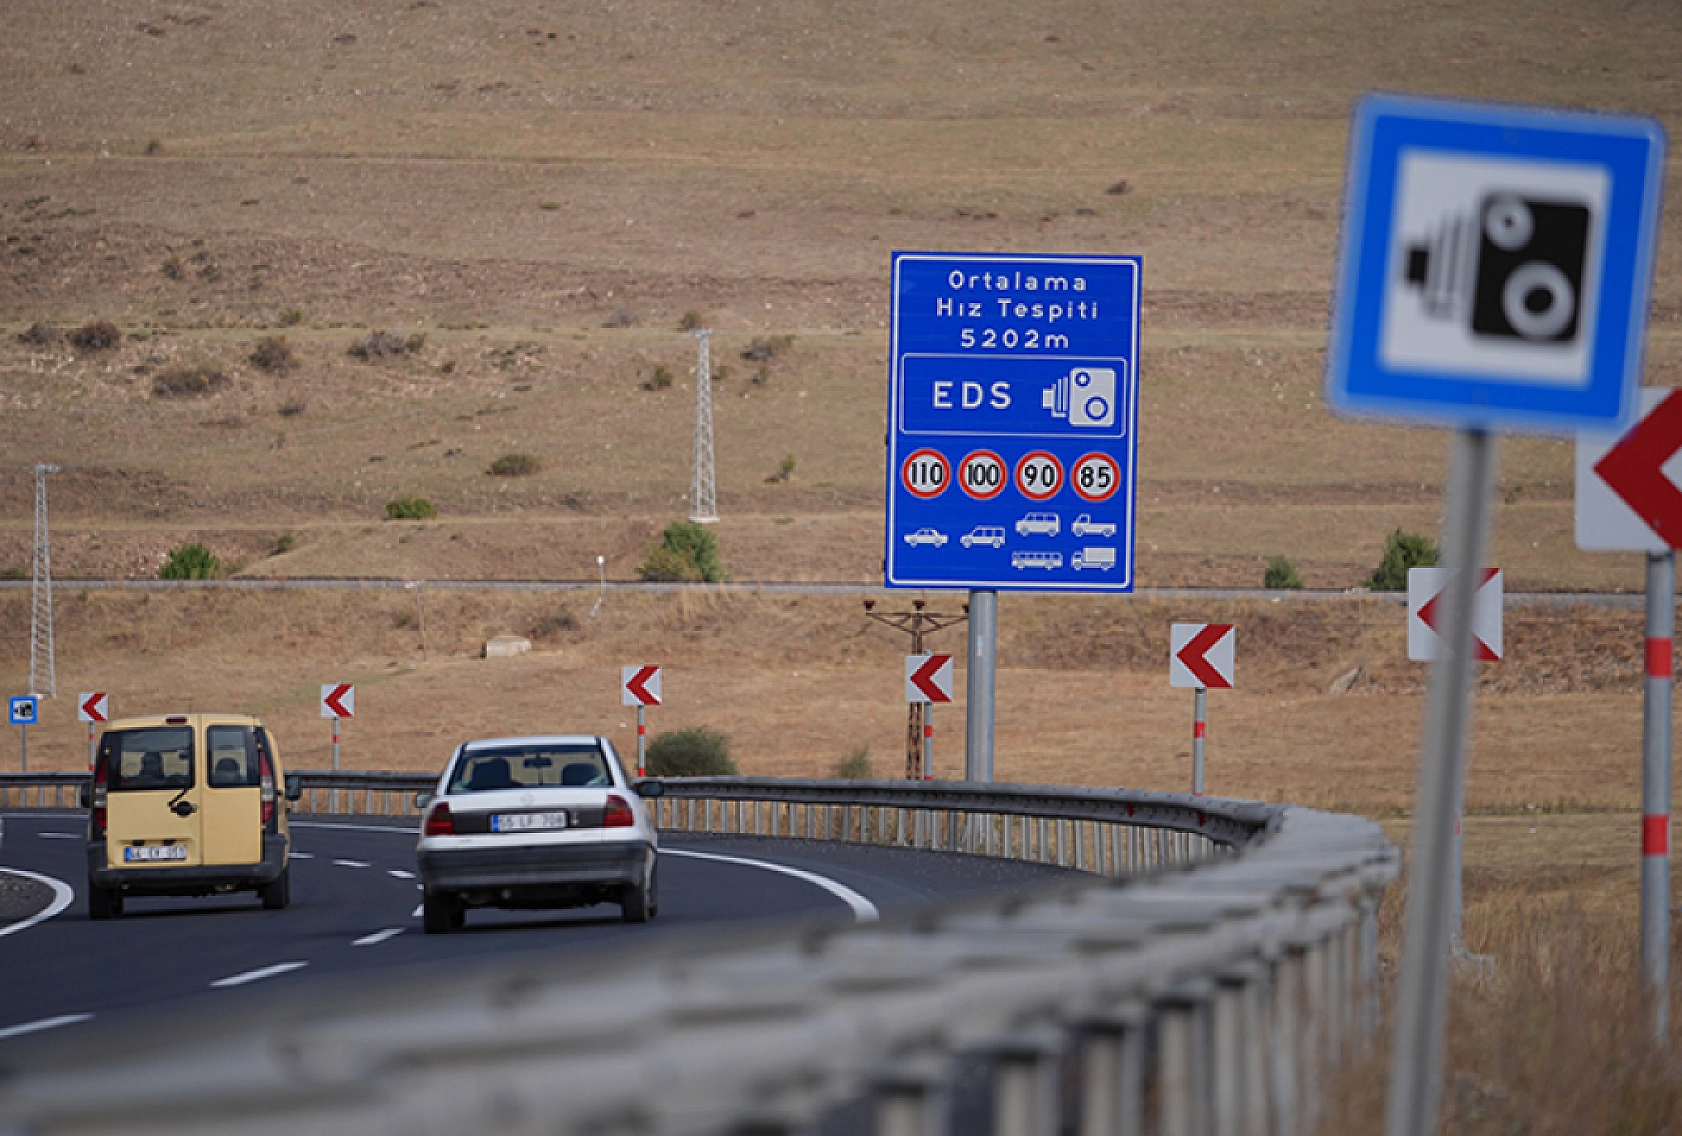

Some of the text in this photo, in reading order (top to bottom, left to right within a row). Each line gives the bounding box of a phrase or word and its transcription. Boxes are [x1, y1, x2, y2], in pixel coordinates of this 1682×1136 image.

[948, 269, 1087, 291] Ortalama
[936, 297, 1099, 323] Hız Tespiti
[960, 328, 1069, 348] 5202m
[932, 381, 1013, 409] EDS
[911, 461, 1112, 488] 110 100 90 85
